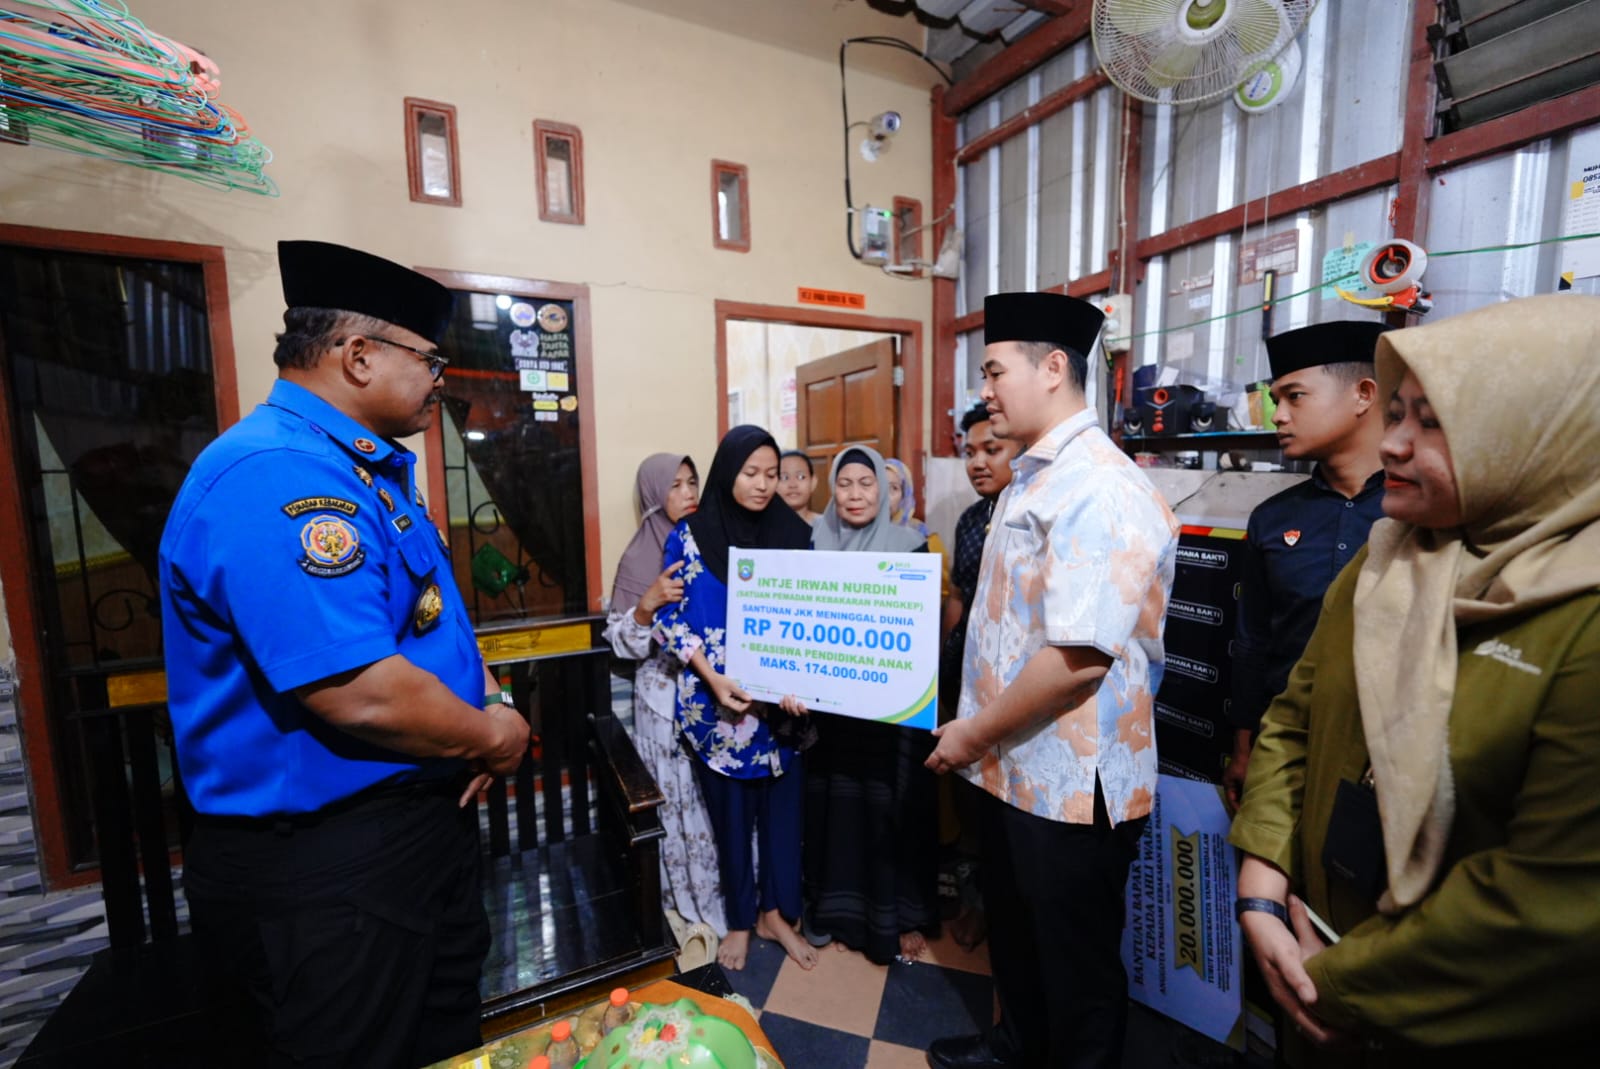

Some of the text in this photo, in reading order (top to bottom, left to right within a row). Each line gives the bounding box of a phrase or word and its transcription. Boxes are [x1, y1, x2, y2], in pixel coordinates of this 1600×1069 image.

[1200, 552, 1225, 562] SAKTI
[757, 577, 898, 596] INTJE IRWAN NURDIN
[742, 604, 915, 626] SANTUNAN JKK MENINGGAL DUNIA
[772, 592, 813, 602] PEMADAM
[815, 595, 871, 606] KEBAKARAN
[873, 599, 924, 612] PANGKEP)
[1196, 607, 1220, 618] SAKTI
[743, 617, 912, 653] RP 70.000.000
[749, 642, 802, 657] BEASISWA
[804, 648, 875, 666] PENDIDIKAN
[878, 657, 913, 671] ANAK
[760, 656, 889, 684] MAKS. 174.000.000
[1192, 664, 1216, 677] SAKTI
[1132, 863, 1144, 912] BAPAK
[1143, 864, 1155, 901] AHLI
[1176, 840, 1197, 963] 20.000.000
[1145, 904, 1156, 960] KEPADA
[1132, 914, 1144, 986] BANTUAN
